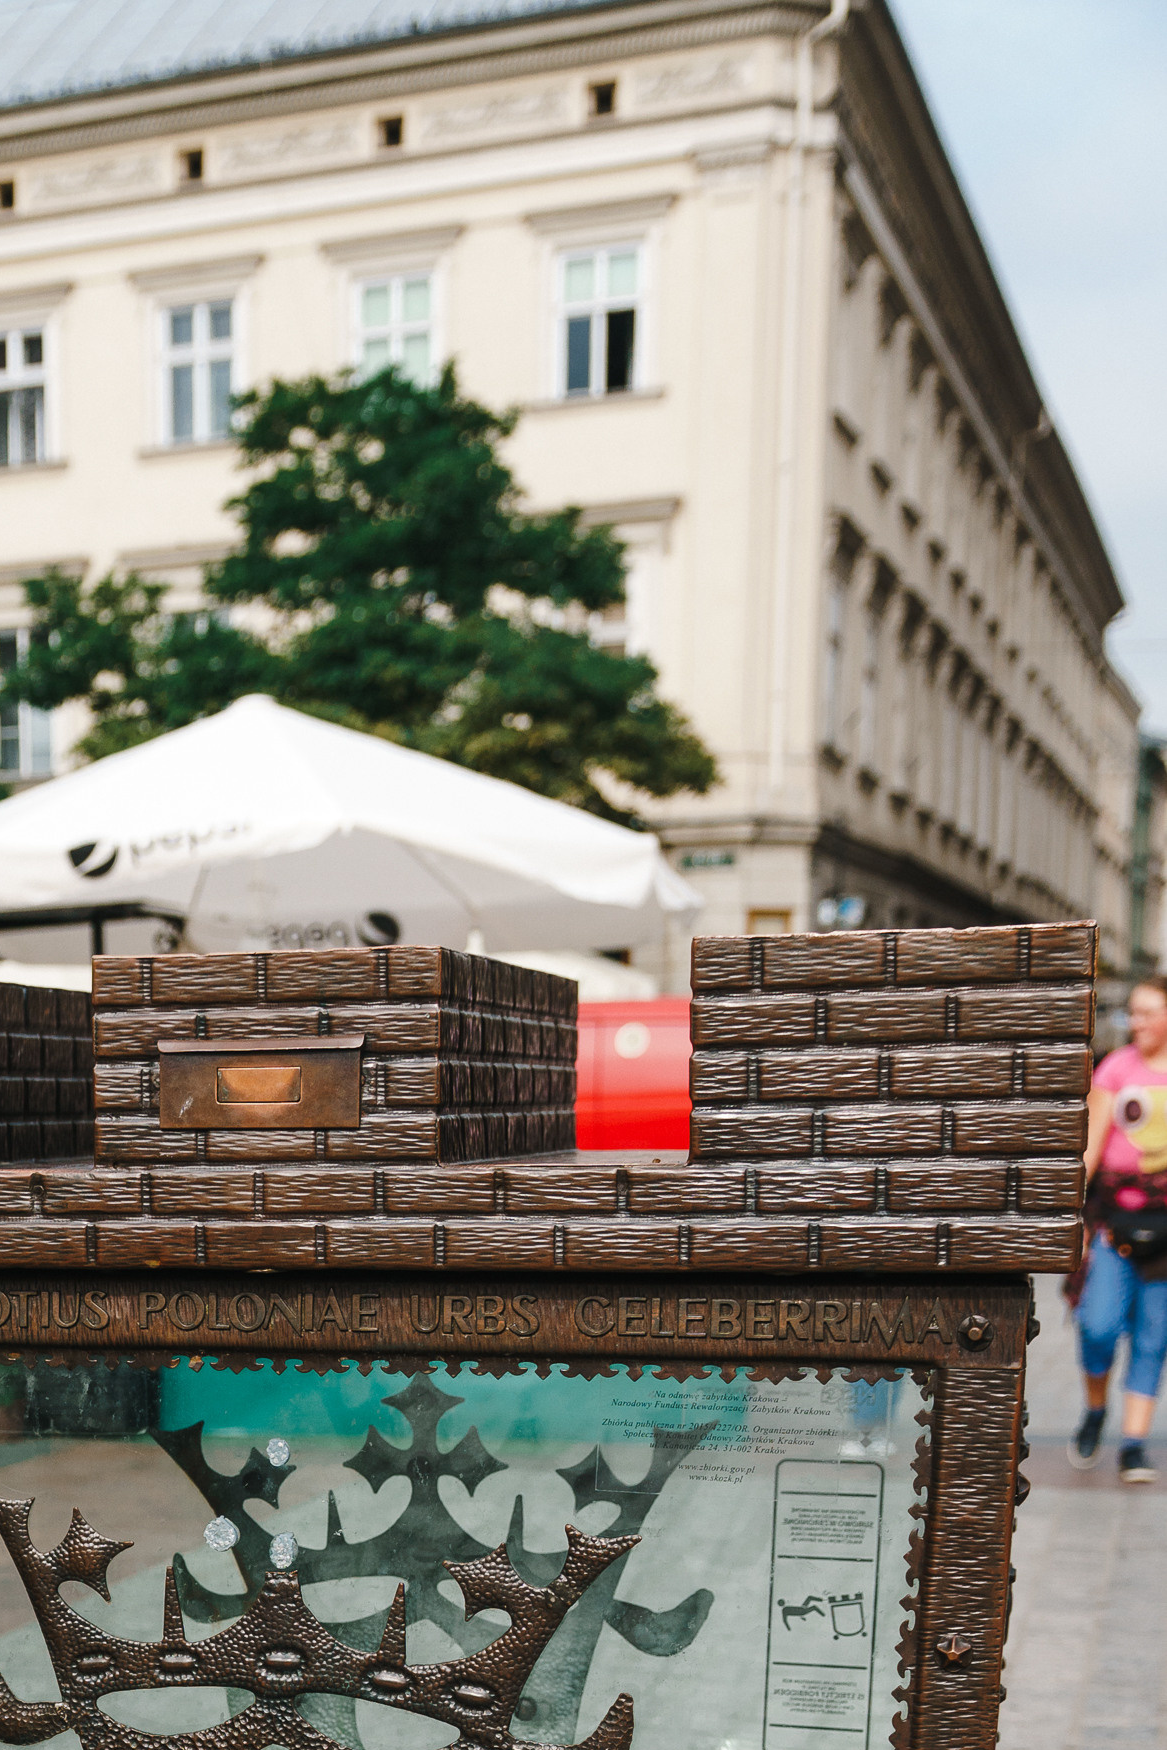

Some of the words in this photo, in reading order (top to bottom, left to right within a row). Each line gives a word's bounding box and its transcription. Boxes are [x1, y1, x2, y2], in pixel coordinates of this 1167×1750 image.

[136, 1289, 379, 1338] POLONIAE
[410, 1293, 541, 1338] URBS
[574, 1295, 954, 1351] CELEBERRIMA
[742, 1394, 779, 1403] Krakowa
[611, 1399, 652, 1409] Narodowy
[654, 1401, 687, 1409] Fundusz
[690, 1402, 748, 1413] Rewaloryzacji
[751, 1405, 790, 1415] Zabytków
[793, 1407, 831, 1416] Krakowa
[601, 1418, 633, 1427] Zbiórka
[635, 1419, 674, 1429] publiczna
[753, 1425, 804, 1436] Organizator
[700, 1433, 733, 1443] Odnowy
[735, 1435, 776, 1445] Zabytków
[777, 1437, 815, 1446] Krakowa
[723, 1444, 752, 1453] 31-002
[754, 1446, 787, 1455] Kraków
[678, 1464, 756, 1475] www.zbiorki.gov.pl
[688, 1474, 744, 1484] www.skozk.pl
